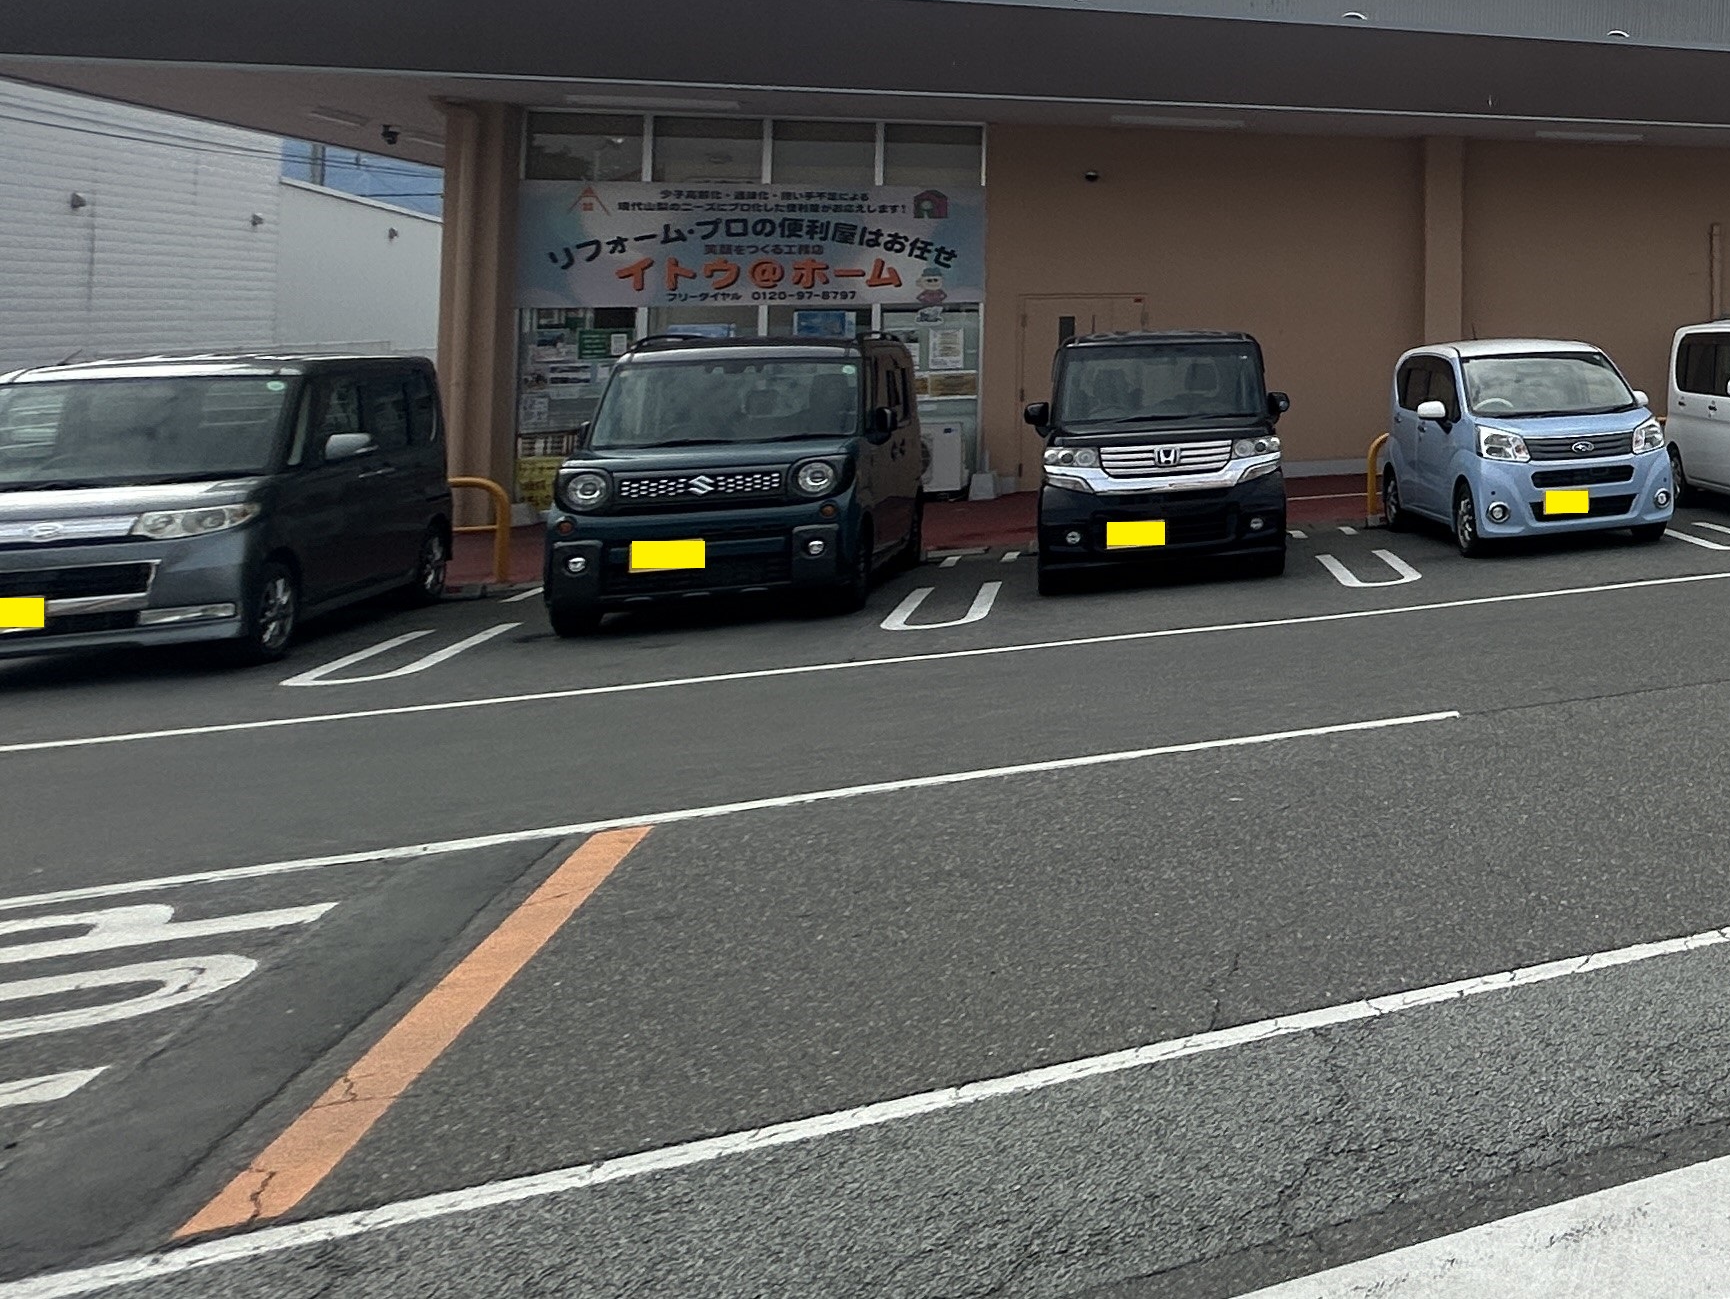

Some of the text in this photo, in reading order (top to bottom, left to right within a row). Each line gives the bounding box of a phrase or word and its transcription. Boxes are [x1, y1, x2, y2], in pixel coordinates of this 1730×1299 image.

[615, 258, 903, 291] イトウ@ホーム
